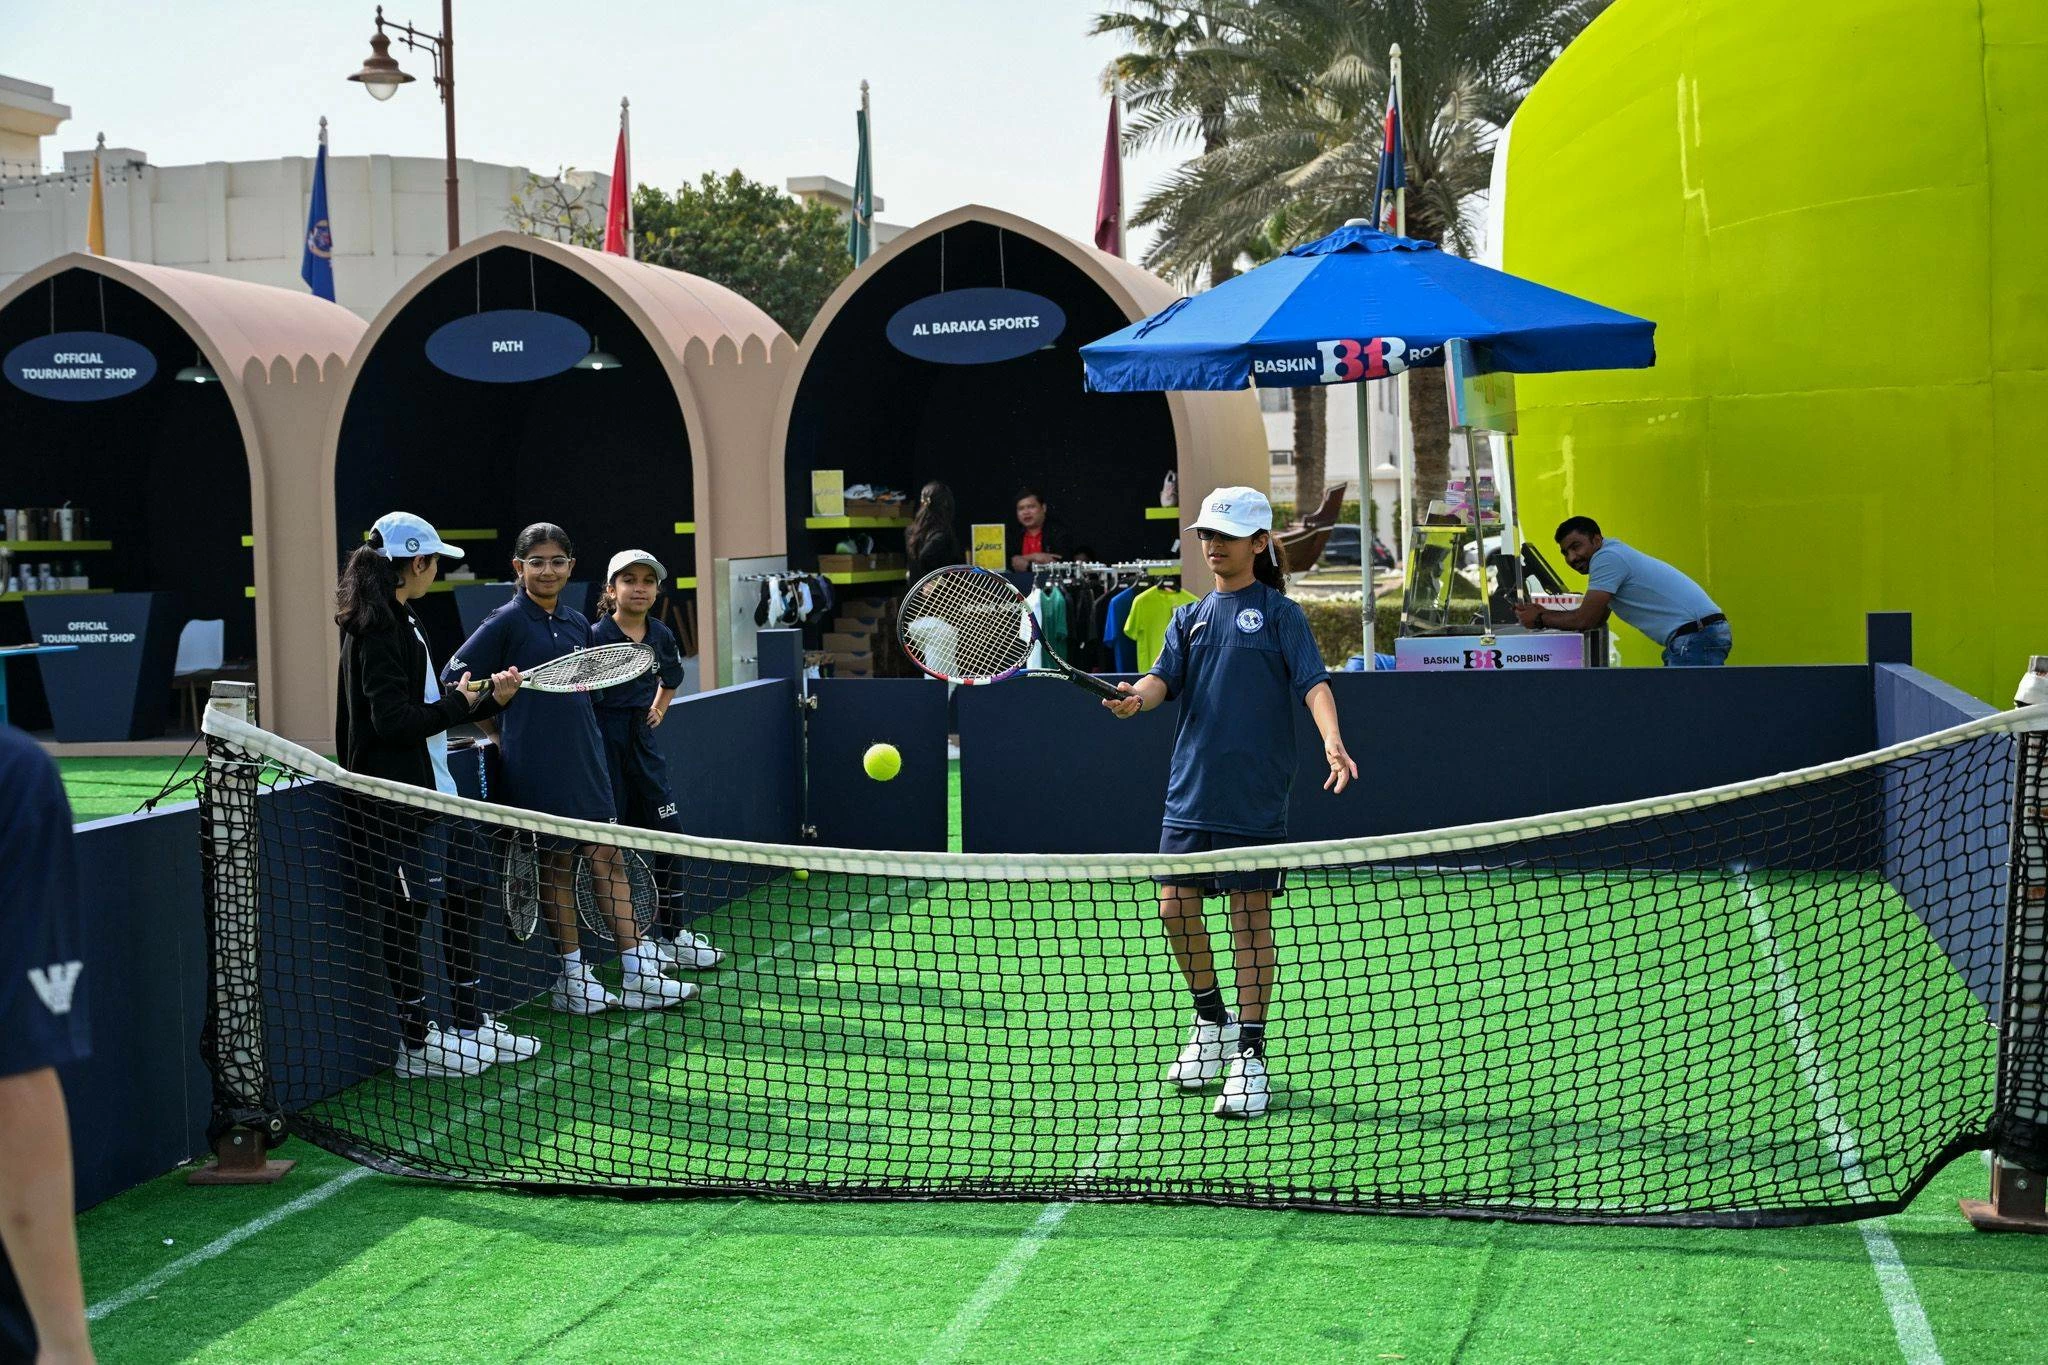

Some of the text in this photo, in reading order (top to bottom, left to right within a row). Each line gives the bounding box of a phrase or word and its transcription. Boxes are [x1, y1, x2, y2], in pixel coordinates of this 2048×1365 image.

[912, 315, 1040, 336] AL BARAKA SPORTS
[492, 340, 523, 353] PATH
[53, 352, 104, 364] OFFICIAL
[1254, 356, 1316, 373] BASKIN
[1409, 346, 1440, 362] RO
[21, 367, 137, 380] TOURNAMENT SHOP
[1211, 502, 1232, 512] EA7
[67, 621, 109, 631] OFFICIAL
[41, 632, 136, 644] TOURNAMENT SHOP
[1423, 656, 1460, 665] BASKIN
[1506, 654, 1551, 663] ROBBINS
[657, 802, 676, 816] EA7
